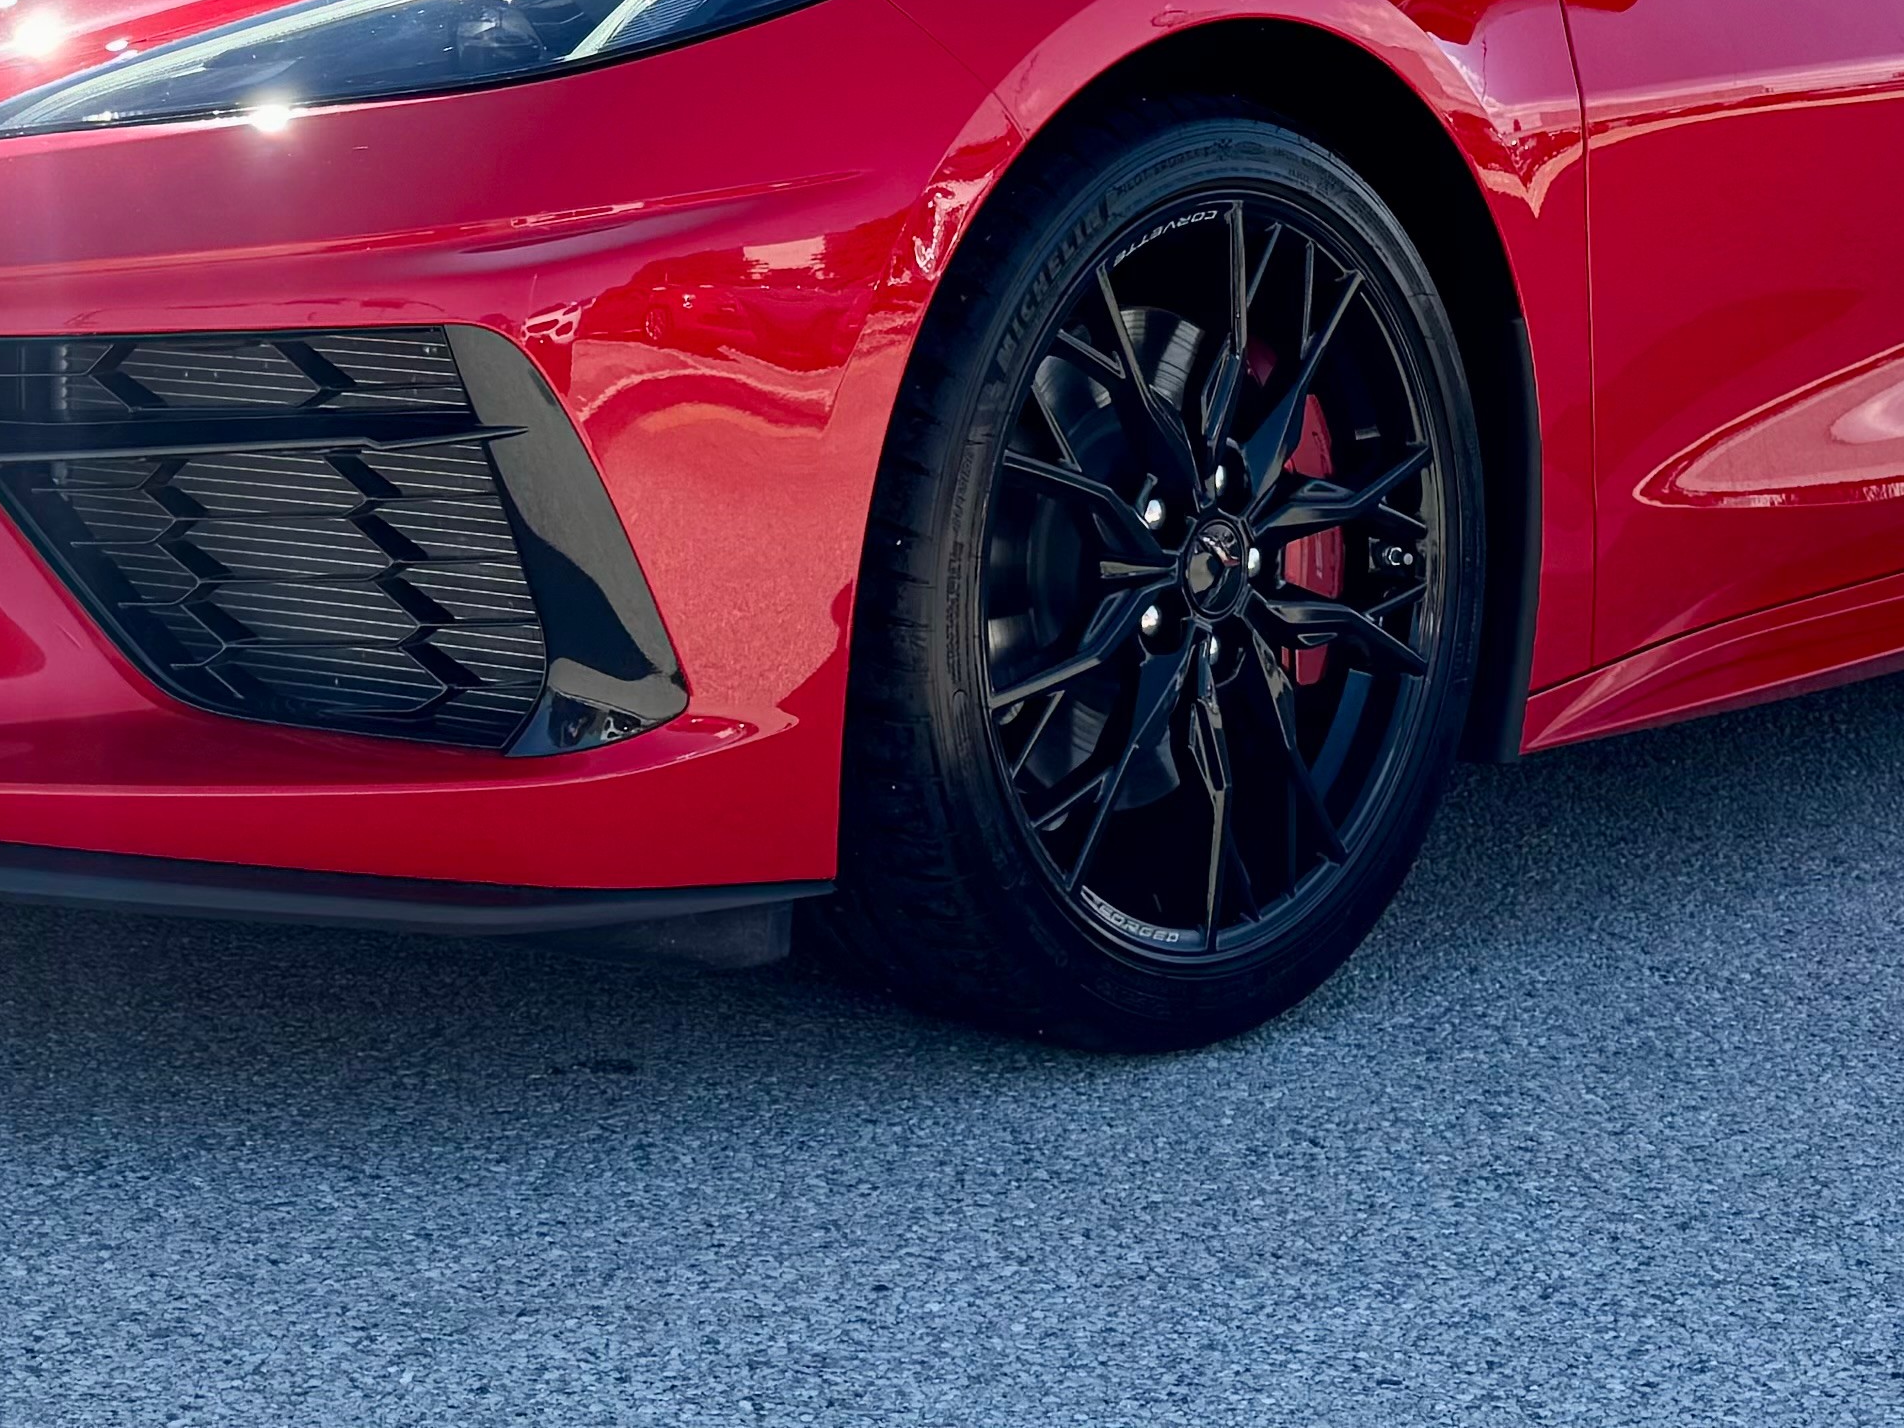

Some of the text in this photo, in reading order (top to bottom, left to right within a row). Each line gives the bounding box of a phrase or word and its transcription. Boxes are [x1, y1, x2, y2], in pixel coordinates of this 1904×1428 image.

[1113, 209, 1218, 268] CORVETTE
[995, 199, 1105, 374] MICHELIN
[1097, 903, 1180, 943] FORGED
